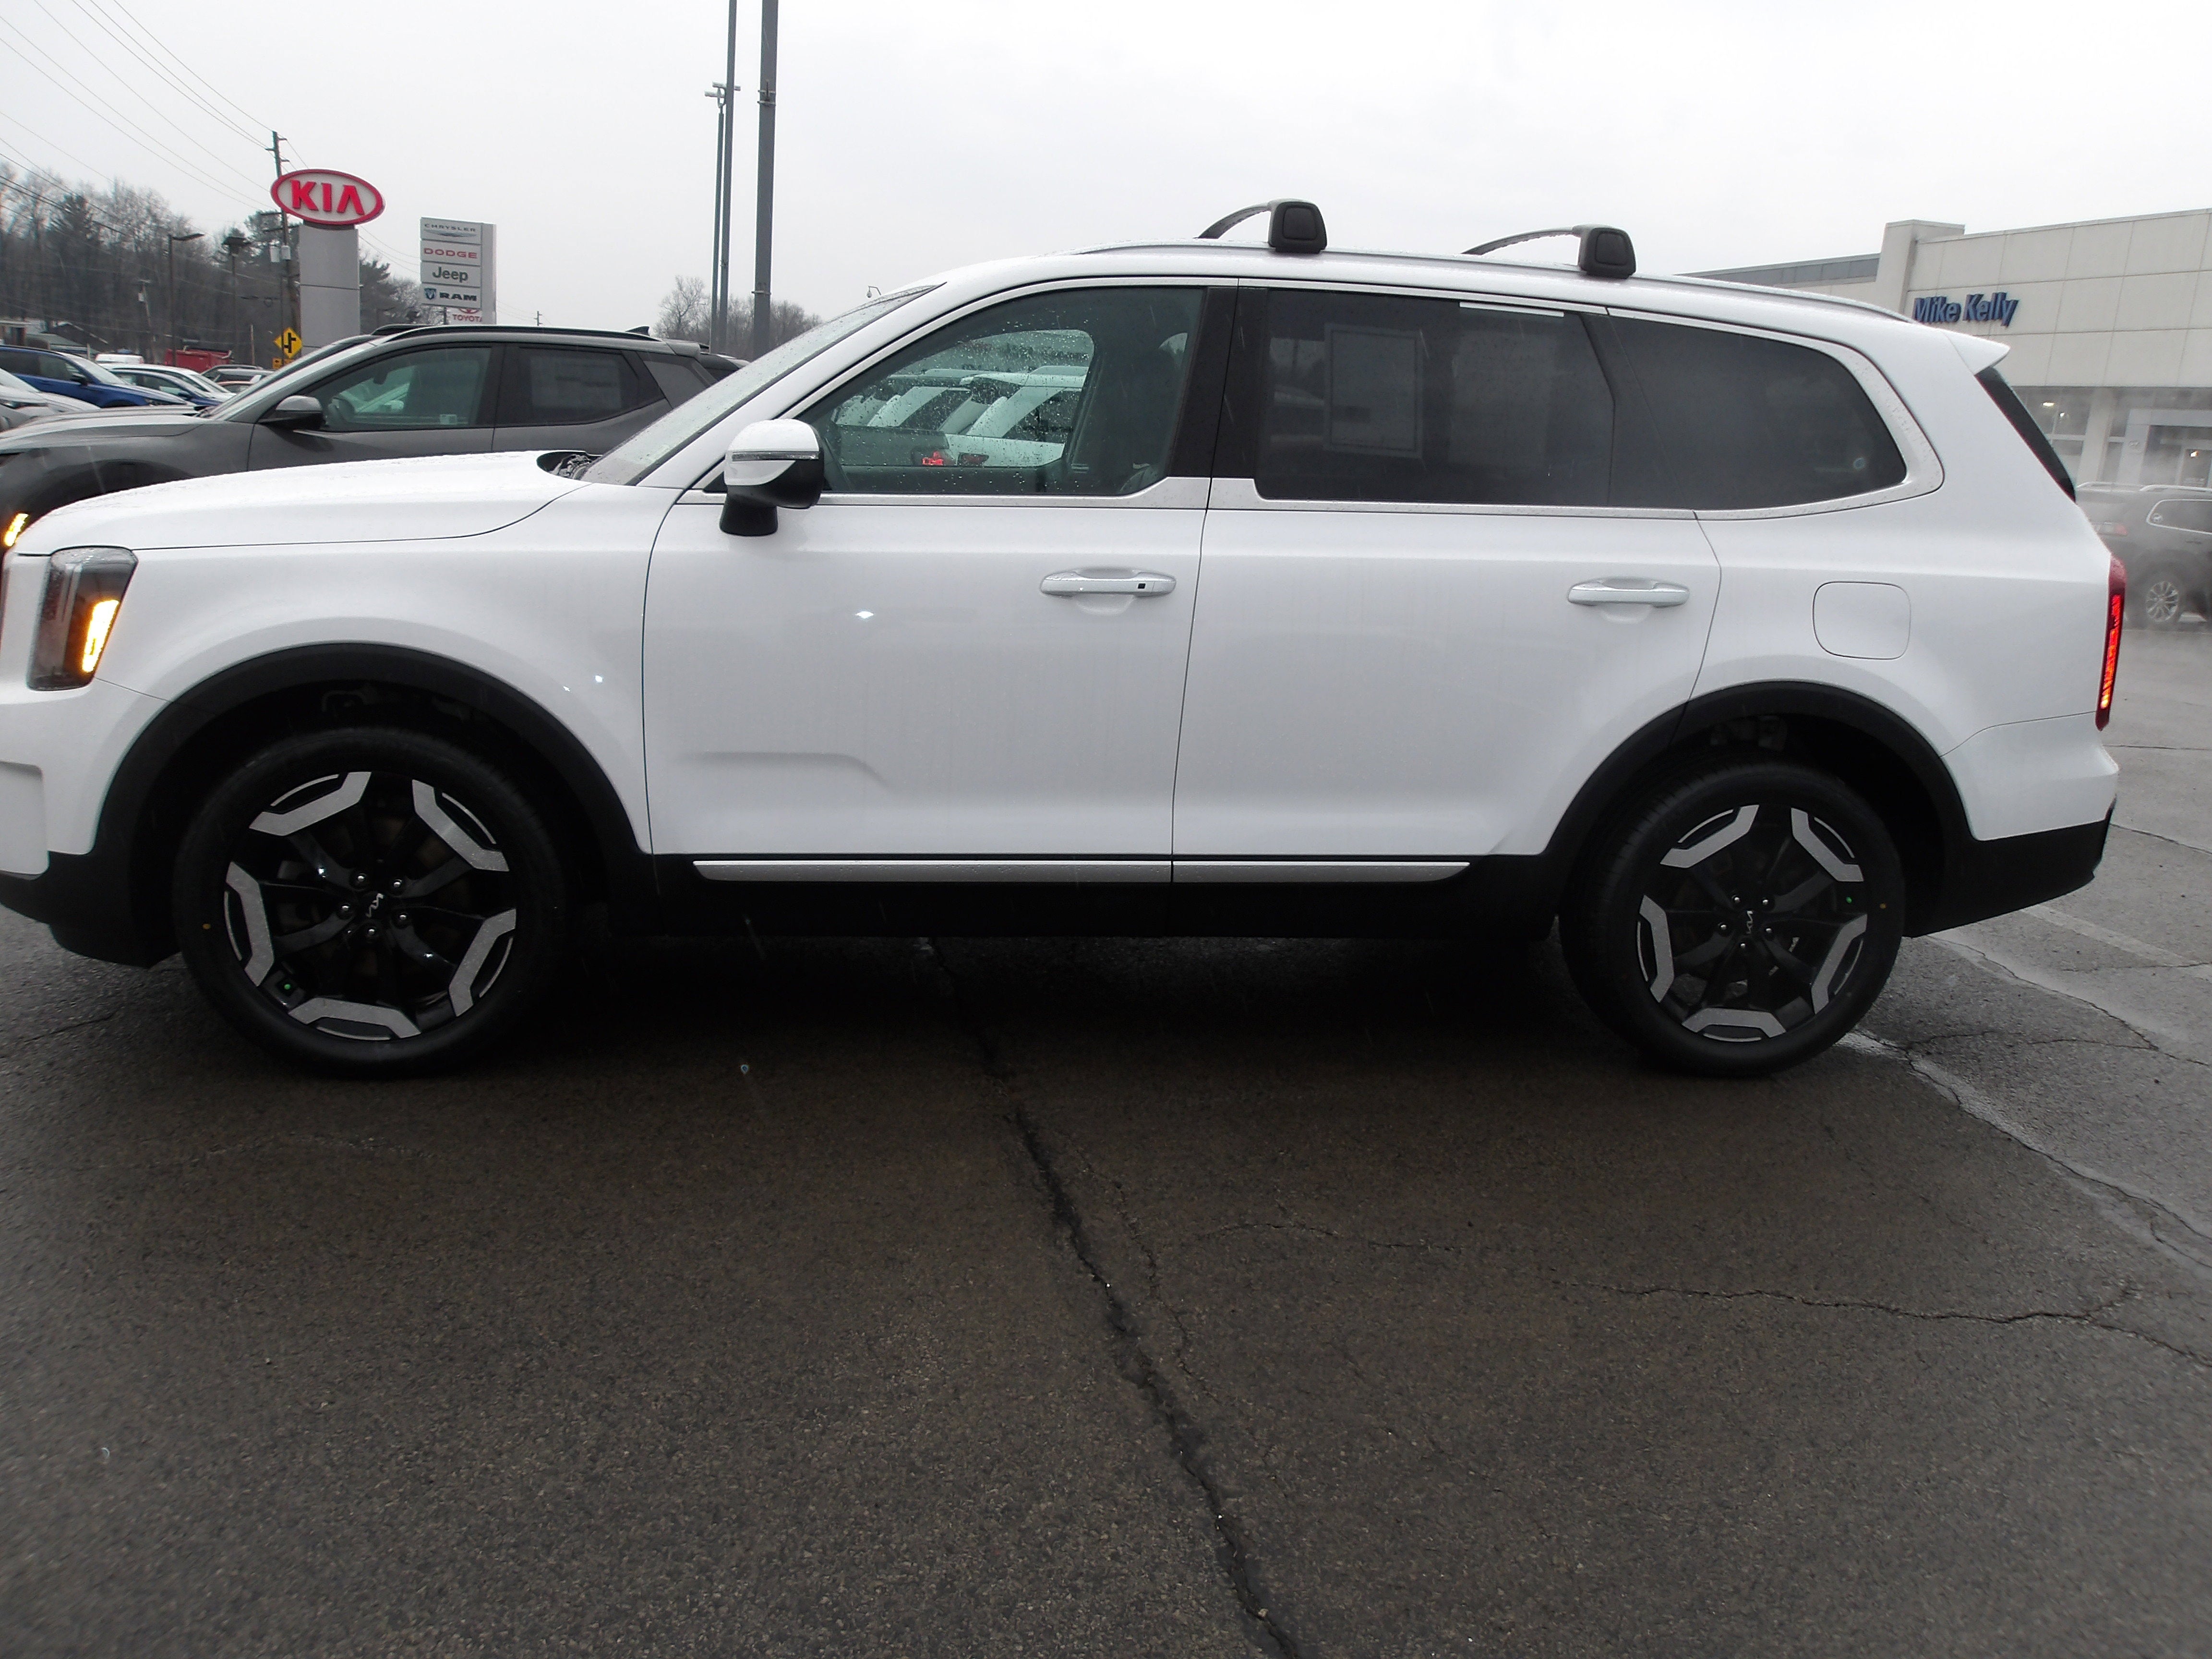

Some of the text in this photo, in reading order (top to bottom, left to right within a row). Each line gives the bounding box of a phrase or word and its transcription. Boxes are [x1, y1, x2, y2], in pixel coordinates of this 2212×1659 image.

[290, 180, 365, 215] KIA
[424, 223, 476, 231] CHRYSLER
[424, 248, 477, 258] DODGE
[433, 266, 468, 283] Jeep
[439, 291, 477, 301] RAM
[1912, 291, 2019, 327] Mike Kelly
